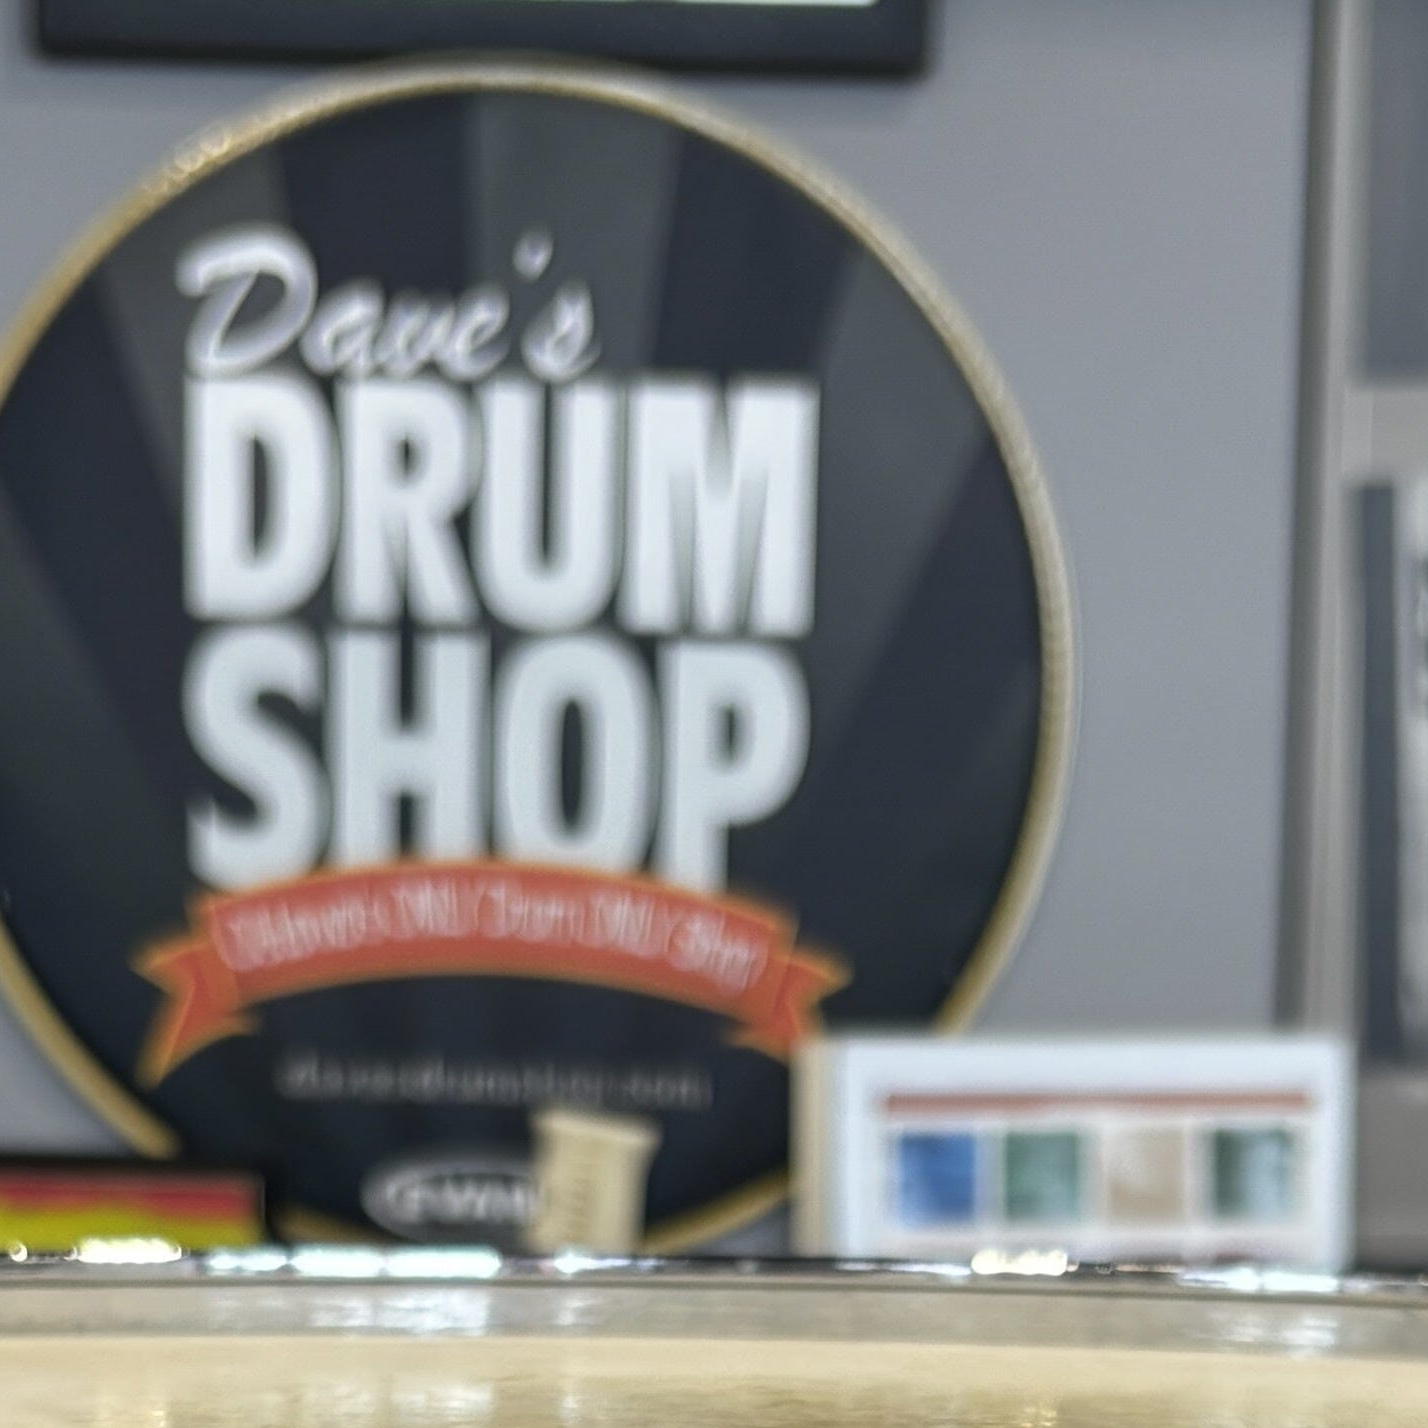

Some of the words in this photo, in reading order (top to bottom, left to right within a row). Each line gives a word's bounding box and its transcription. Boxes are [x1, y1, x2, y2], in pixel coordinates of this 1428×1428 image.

[176, 228, 600, 377] Dave's
[182, 375, 820, 638] DRUM
[184, 622, 812, 893] SHOP
